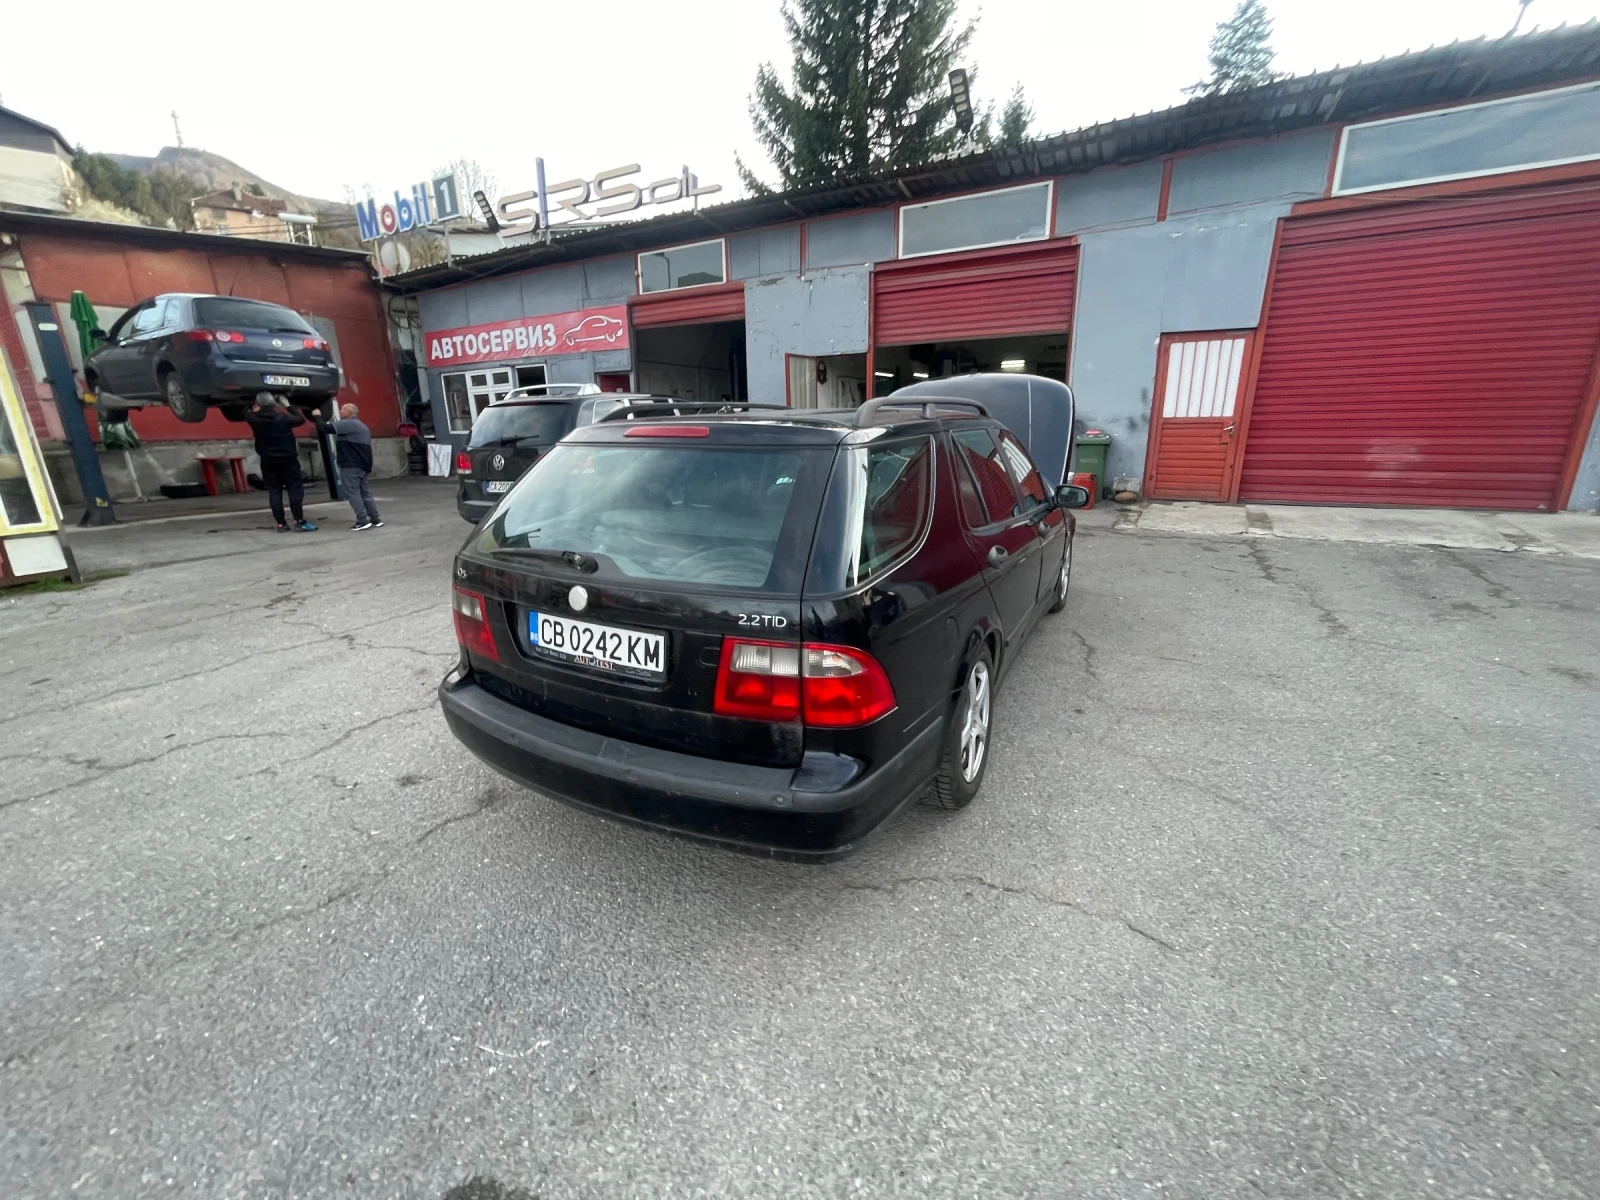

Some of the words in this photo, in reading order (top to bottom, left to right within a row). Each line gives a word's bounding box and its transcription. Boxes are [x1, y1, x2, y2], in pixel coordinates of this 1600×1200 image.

[355, 181, 433, 242] Mobil
[431, 323, 557, 360] АВТОСЕРВИЗ
[569, 625, 622, 661] 0242
